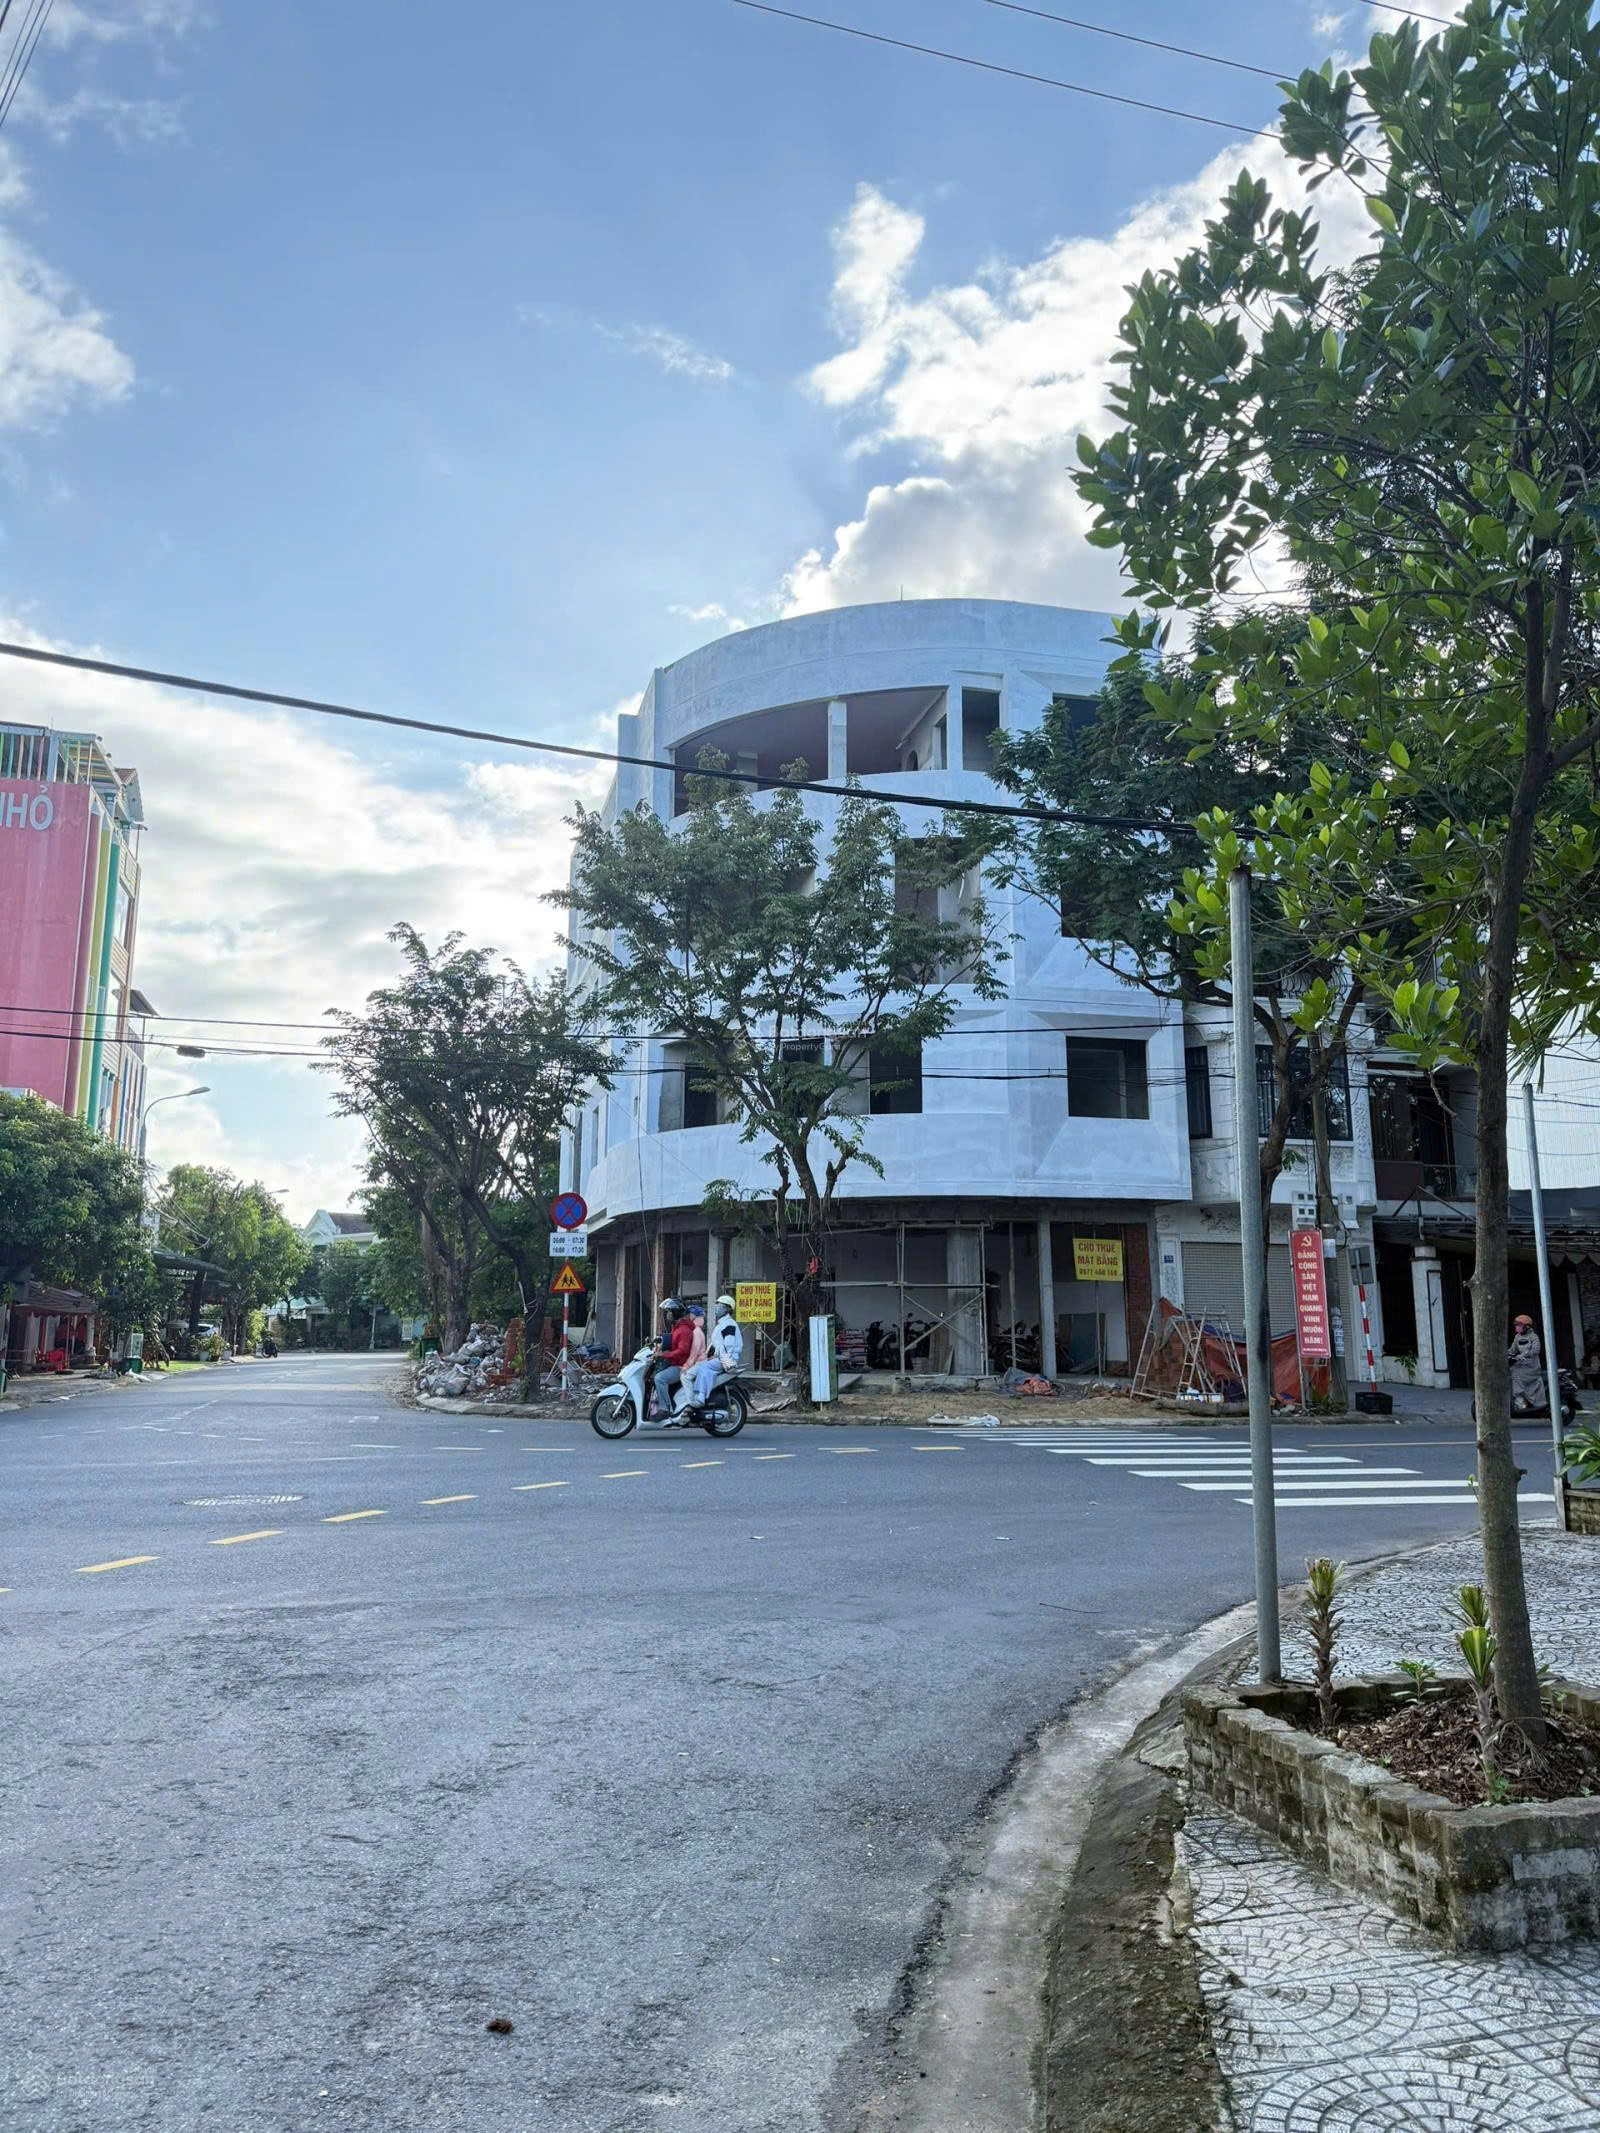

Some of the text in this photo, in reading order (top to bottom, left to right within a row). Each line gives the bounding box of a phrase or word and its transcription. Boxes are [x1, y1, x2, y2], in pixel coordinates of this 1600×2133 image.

[0, 784, 54, 831] HỎ
[1079, 1242, 1095, 1252] CHO
[1297, 1250, 1317, 1259] ĐẢNG
[1298, 1261, 1318, 1271] CỘNG
[1301, 1271, 1316, 1280] SẢN
[740, 1285, 754, 1295] CHO
[1302, 1282, 1317, 1292] VIỆT
[1302, 1294, 1319, 1302] NAM
[1299, 1304, 1323, 1313] QUANG
[1303, 1315, 1321, 1323] VINH
[1302, 1325, 1324, 1334] MUÔN
